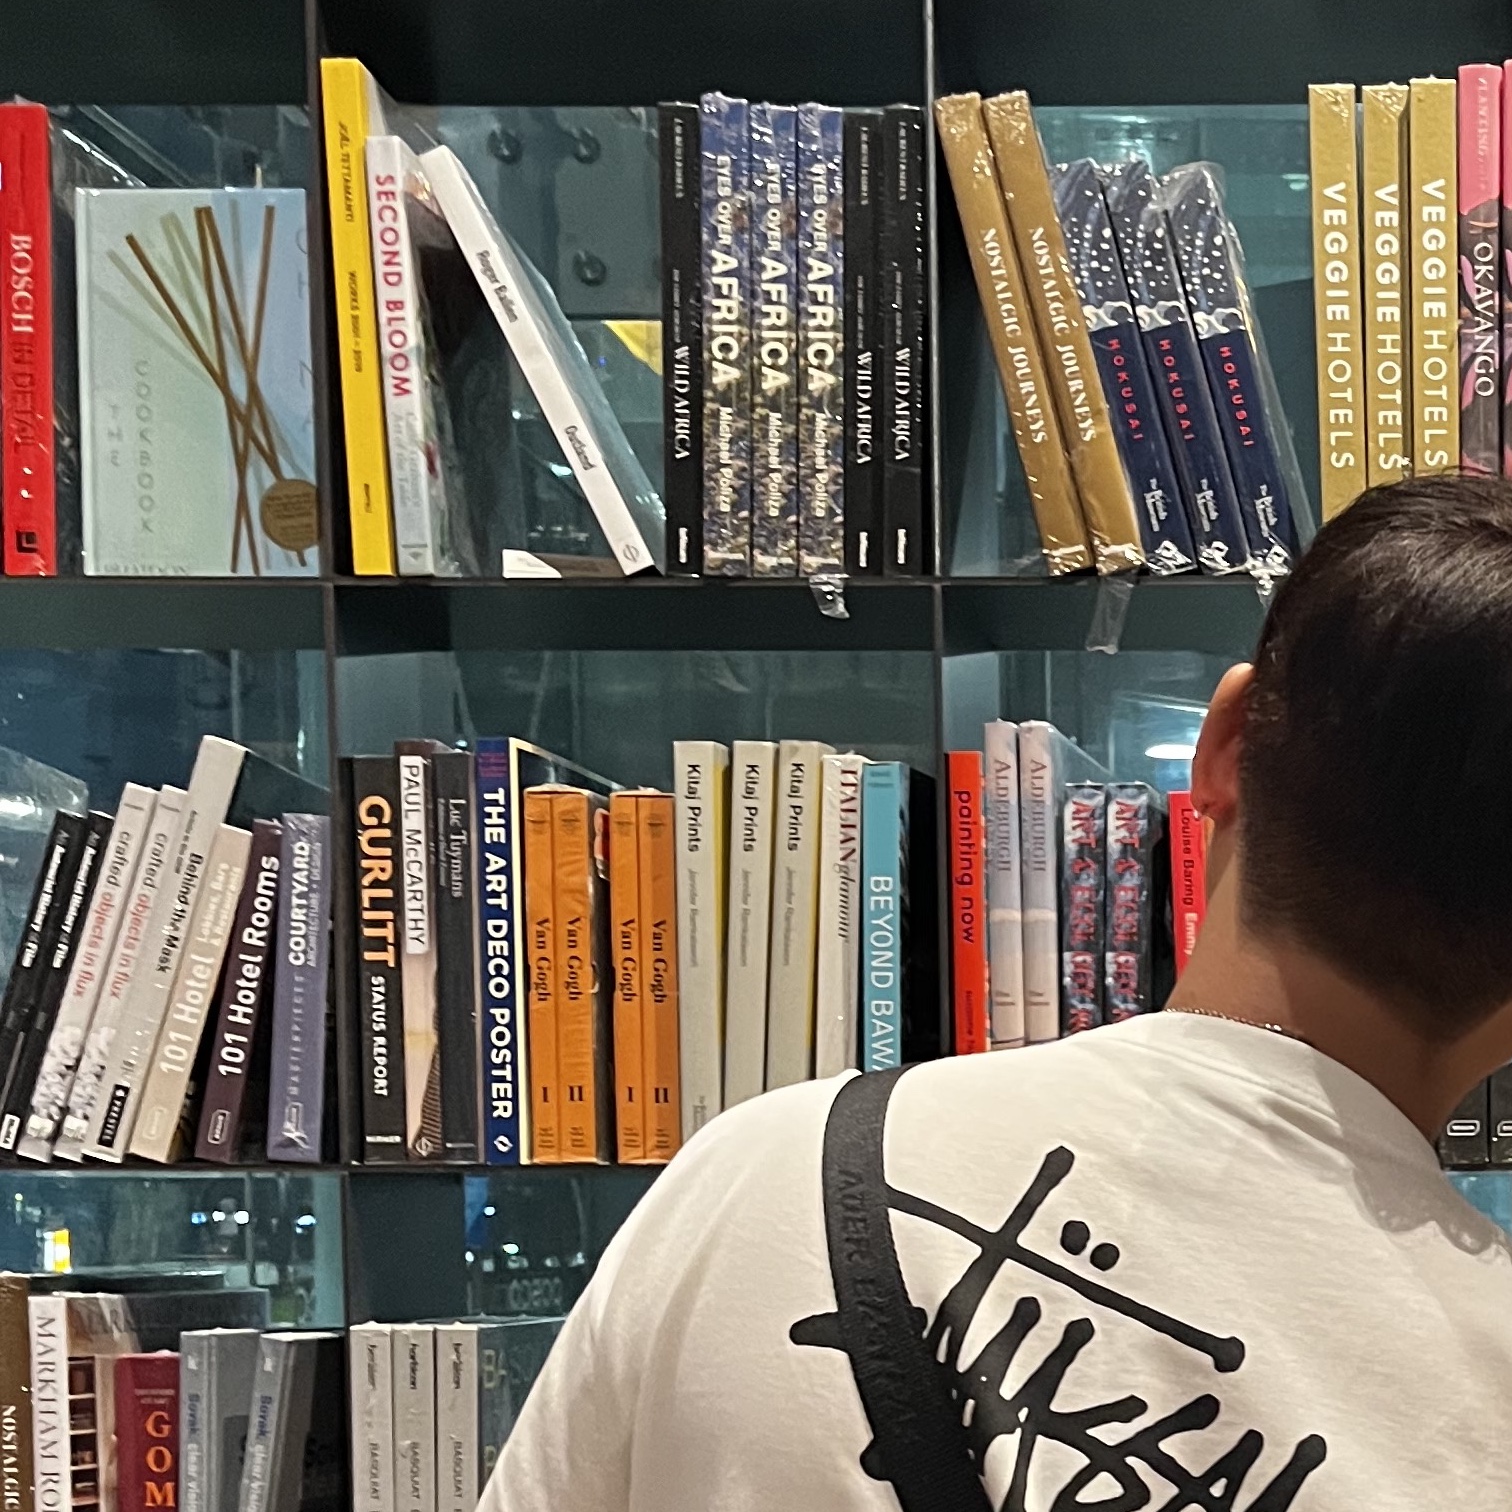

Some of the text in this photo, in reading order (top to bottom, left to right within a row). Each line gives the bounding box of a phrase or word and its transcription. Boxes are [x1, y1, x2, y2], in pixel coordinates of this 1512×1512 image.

[375, 174, 402, 289] SECOND
[718, 201, 732, 246] OVER
[11, 234, 34, 333] BOSCH
[712, 250, 739, 386] AFRICA
[980, 228, 1047, 444] NOSTALGIC JOURNEYS
[1029, 227, 1096, 442] NOSTALGIC JOURNEYS
[1322, 182, 1355, 469] VEGGIE HOTELS
[1374, 184, 1406, 470] VEGGIE HOTELS
[1473, 241, 1495, 397] OKAVANGO
[384, 299, 411, 398] BLOOM
[675, 345, 690, 393] WILD
[1108, 338, 1142, 440] HOKUSAI
[1159, 339, 1194, 441] HOKUSAI
[674, 395, 691, 460] AFRICA
[483, 788, 506, 844] THE
[684, 764, 701, 800] Kitaj
[687, 806, 702, 853] Prints
[994, 759, 1012, 872] ALDEBURGH
[180, 852, 204, 909] Behind
[288, 837, 313, 967] COURTYARD
[358, 795, 394, 968] GURLITT
[403, 764, 424, 946] PAUL McCARTHY
[445, 798, 467, 898] Luc Tuymans
[486, 853, 507, 911] ART
[953, 789, 974, 944] painting now
[1181, 809, 1194, 905] Louise Baring
[73, 830, 130, 998] crafted objects in flux
[156, 936, 177, 974] Mask
[218, 854, 280, 1077] 101 Hotel Rooms
[487, 919, 509, 996] DECO
[534, 917, 551, 1002] Van Gogh
[161, 949, 209, 1075] 101 Hotel
[869, 877, 895, 1071] BEYOND BAW
[371, 976, 388, 1097] STATUS REPORT
[489, 1007, 512, 1119] POSTER
[36, 1316, 58, 1460] MARKHAM
